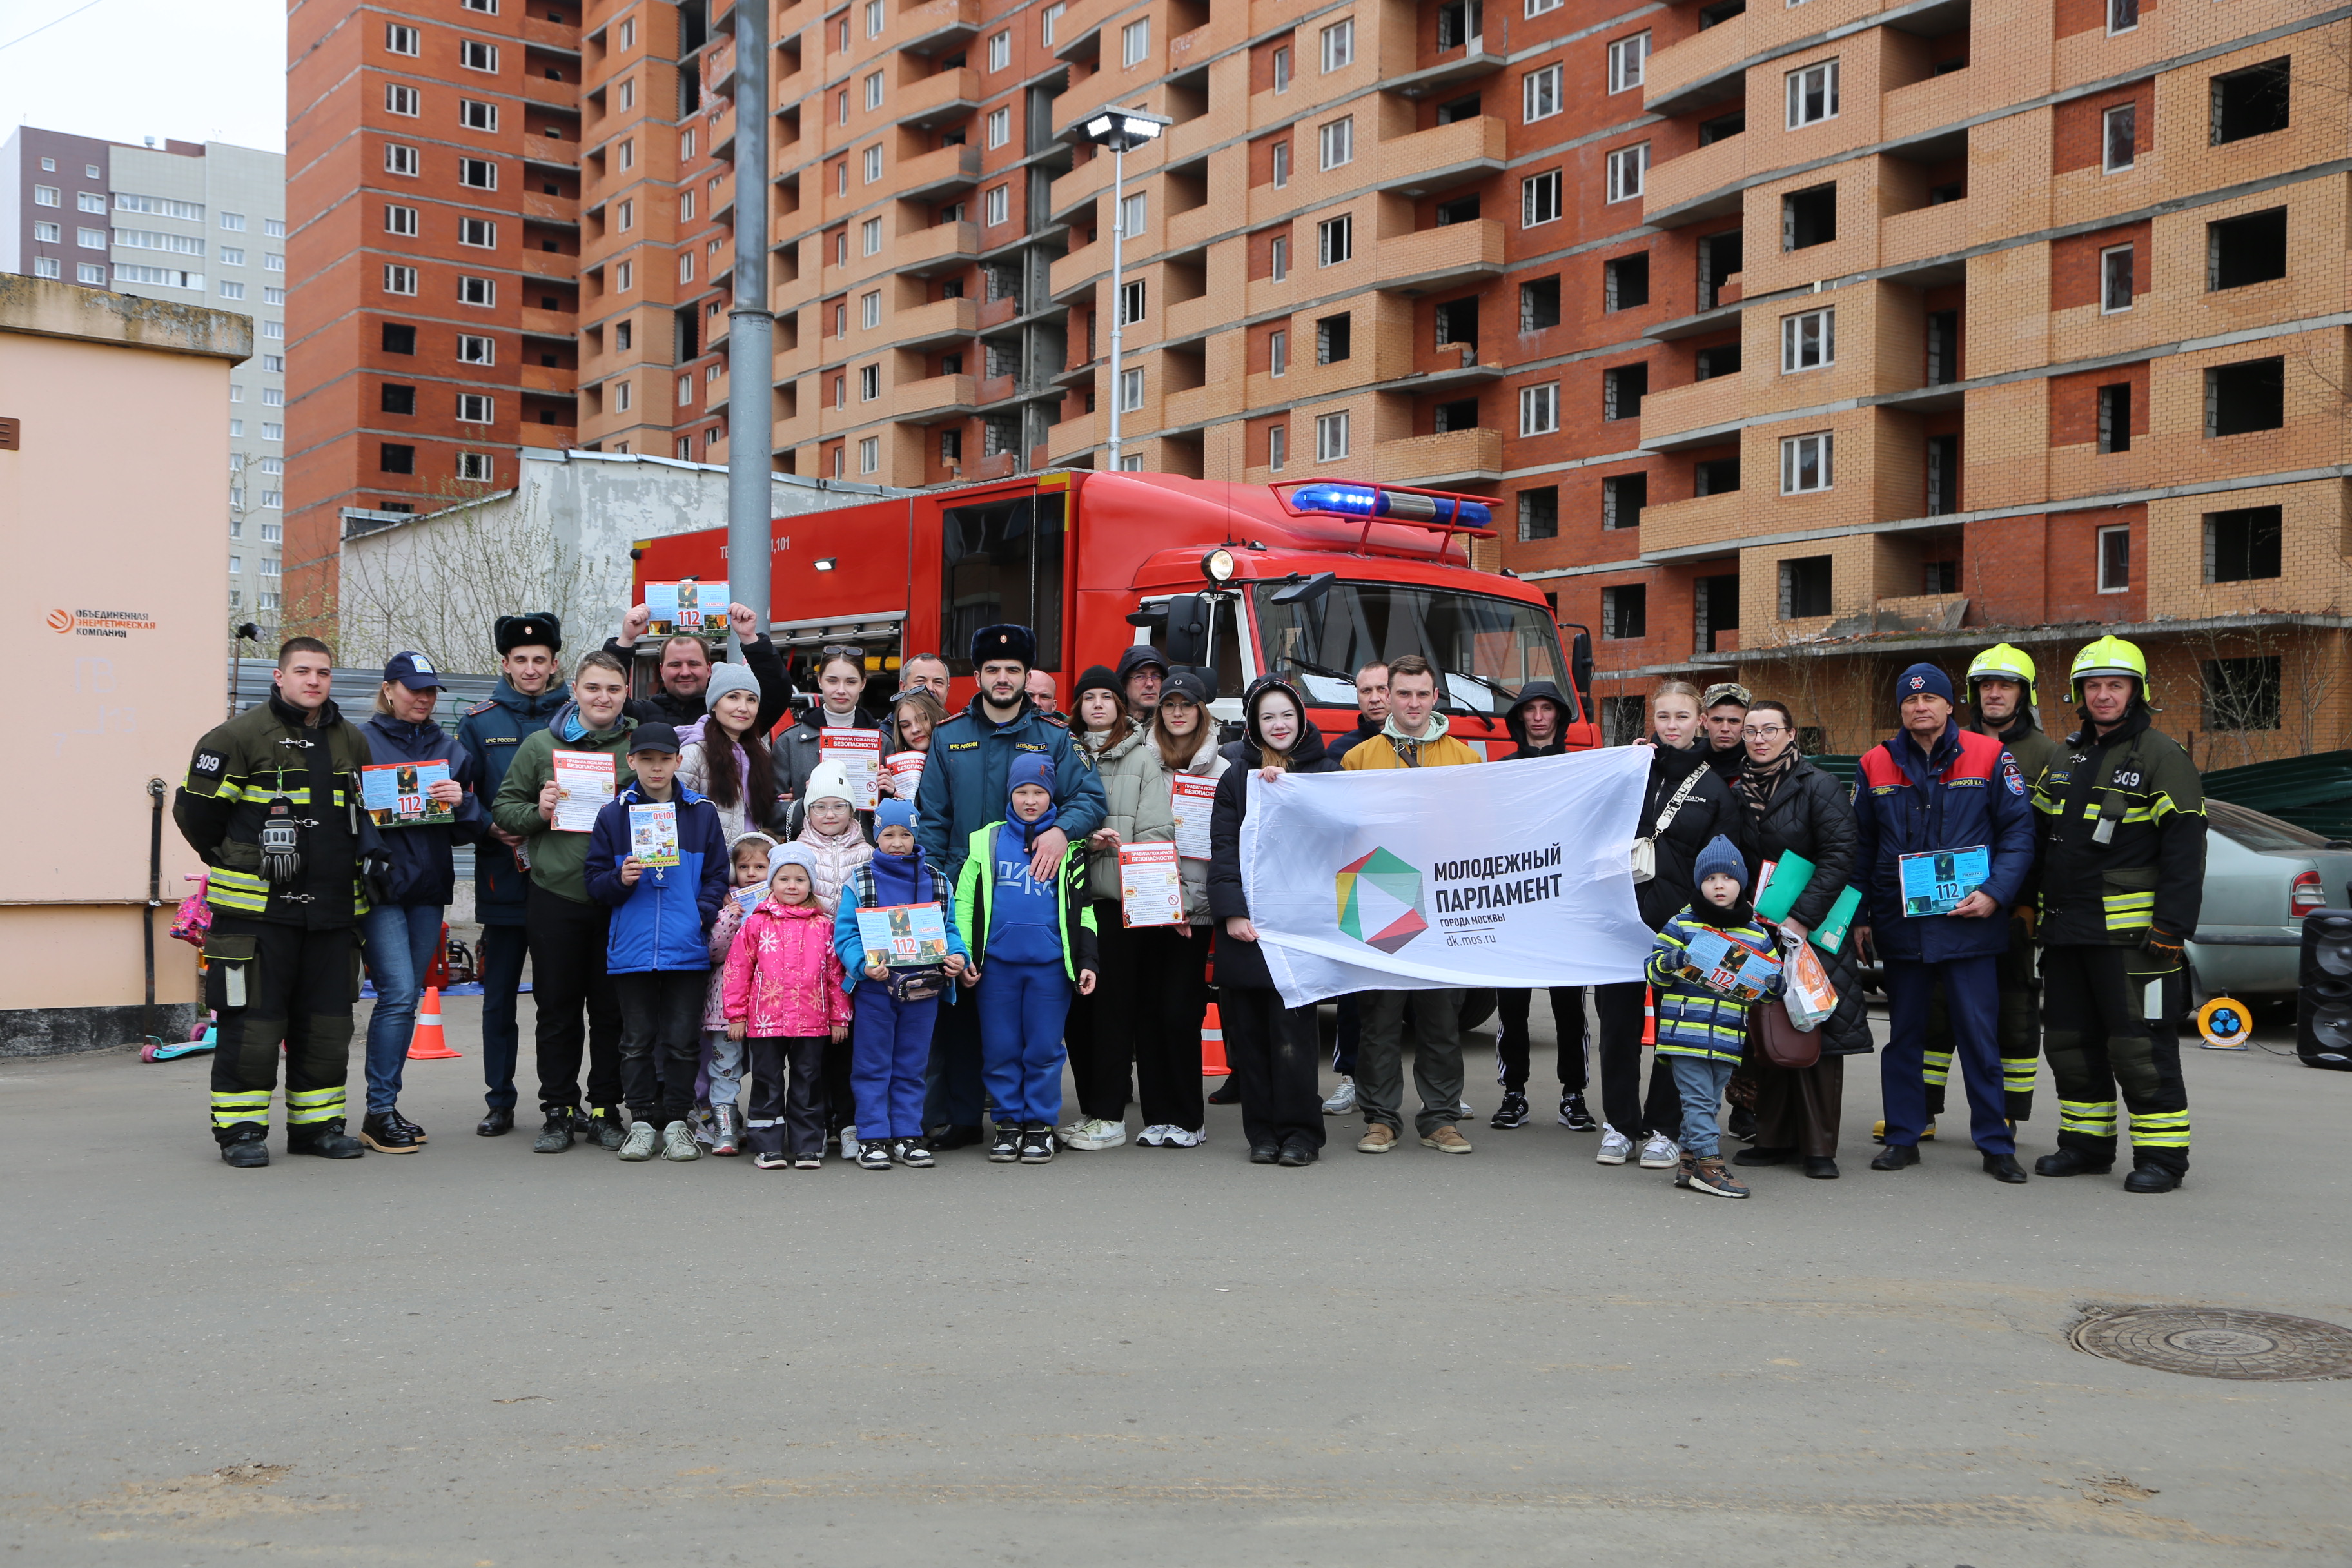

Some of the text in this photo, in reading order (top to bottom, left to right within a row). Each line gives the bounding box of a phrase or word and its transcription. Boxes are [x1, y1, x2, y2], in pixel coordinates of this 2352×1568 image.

[76, 609, 149, 621] ОБЪЕДИНЕННАЯ
[677, 611, 700, 625] 112
[76, 627, 127, 638] КОМПАНИЯ
[77, 619, 157, 630] ЭНЕРГЕТИЧЕСКАЯ
[196, 754, 220, 772] 309
[1949, 779, 1974, 787] НИКИФОРОВ
[2113, 770, 2140, 787] 309
[398, 796, 422, 812] 112
[1434, 842, 1562, 881] МОЛОДЕЖНЫЙ
[1435, 873, 1562, 913] ПАРЛАМЕНТ
[1935, 883, 1959, 899] 112
[1440, 913, 1506, 928] ГОРОДА МОСКВЫ
[892, 937, 917, 954] 112
[1446, 934, 1496, 947] dk.mos.ru
[1710, 968, 1736, 988] 112
